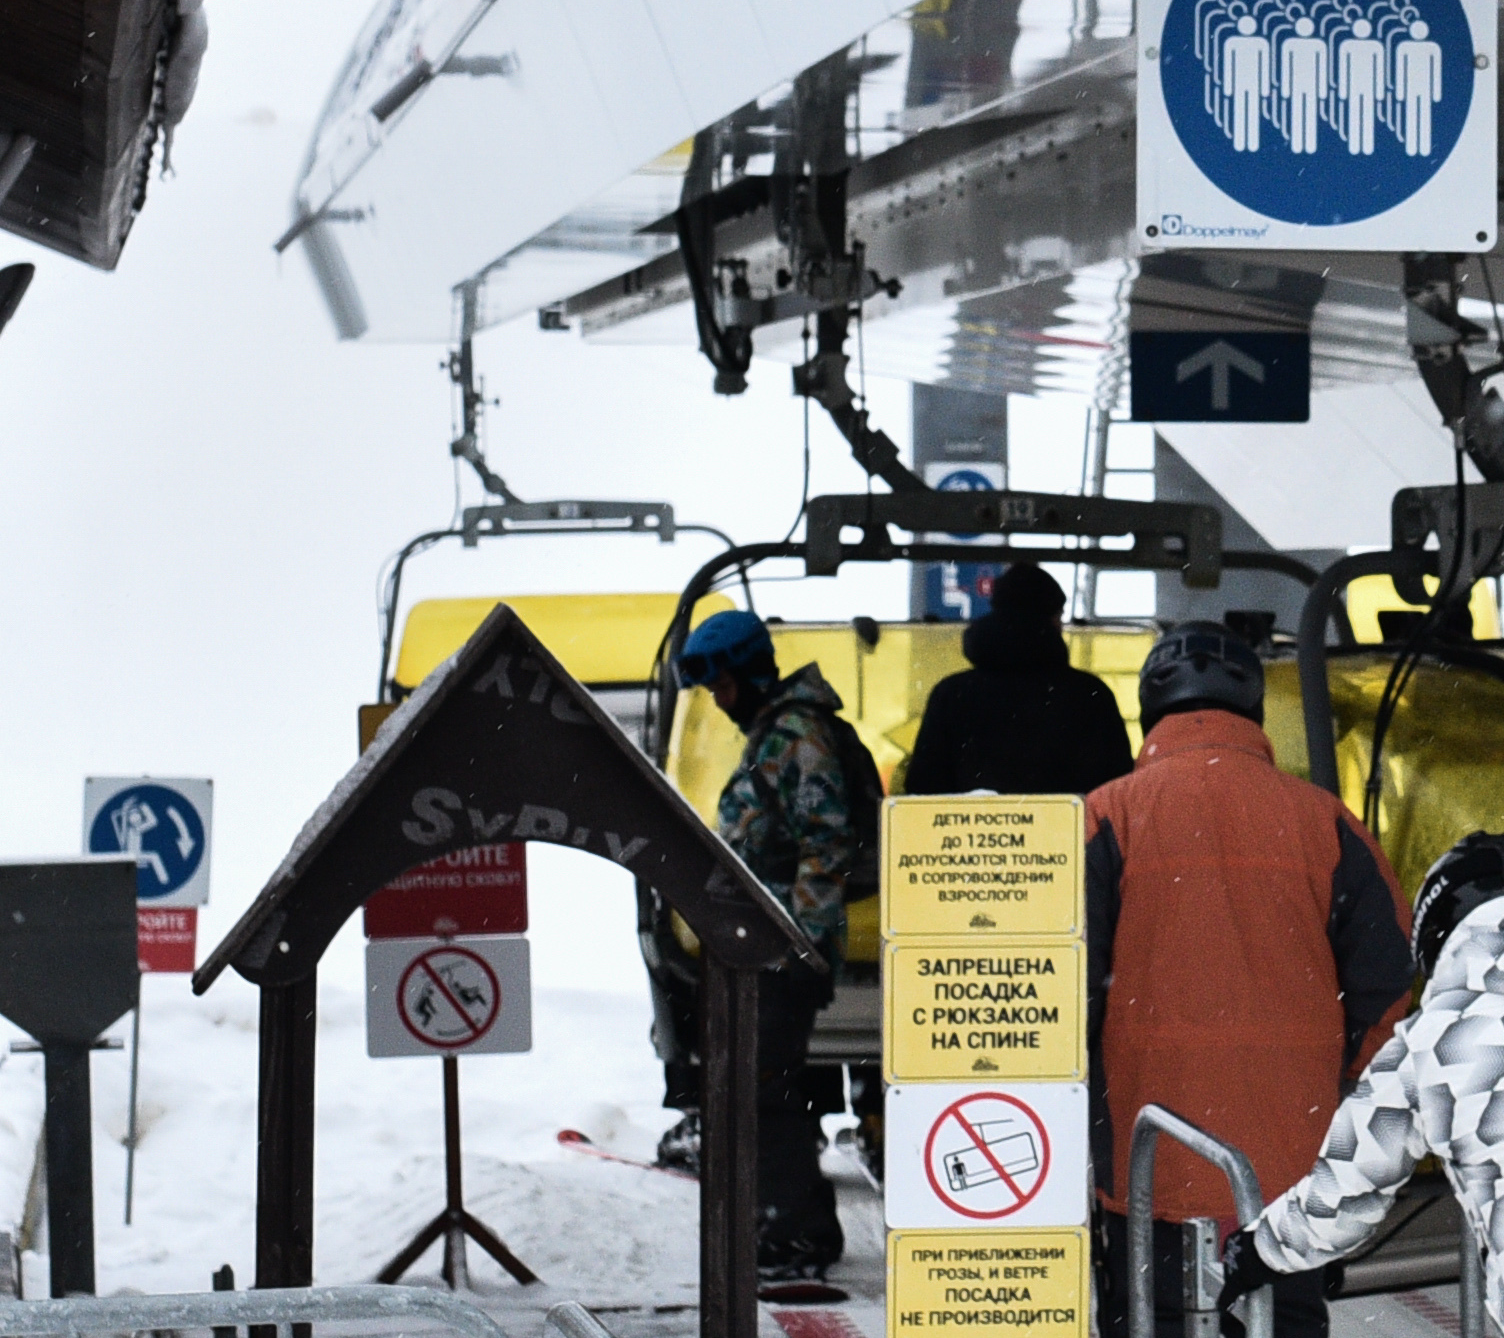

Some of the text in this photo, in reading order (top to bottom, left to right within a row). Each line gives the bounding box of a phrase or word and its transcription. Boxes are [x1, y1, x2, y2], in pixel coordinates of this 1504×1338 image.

[932, 812, 1034, 828] ДЕТИ РОСТОМ
[898, 852, 1068, 868] ДОПУСКАЮТСЯ ТОЛЬКО
[908, 871, 1054, 886] В СОПРОВОЖДЕНИИ
[937, 887, 1029, 903] ВЗРОСЛОГО!
[917, 956, 1056, 978] ЗАПРЕЩЕНА
[934, 982, 1039, 1003] ПОСАДКА
[912, 1006, 1059, 1026] С РЮКЗАКОМ
[931, 1030, 1040, 1050] НА СПИНЕ
[911, 1247, 1065, 1262] ПРИ ПРИБЛИЖЕНИИ
[988, 1267, 1000, 1280] И
[1003, 1265, 1049, 1280] ВЕТРЕ
[945, 1286, 1032, 1305] ПОСАДКА
[900, 1308, 1075, 1327] НЕ ПРОИЗВОДИТСЯ
